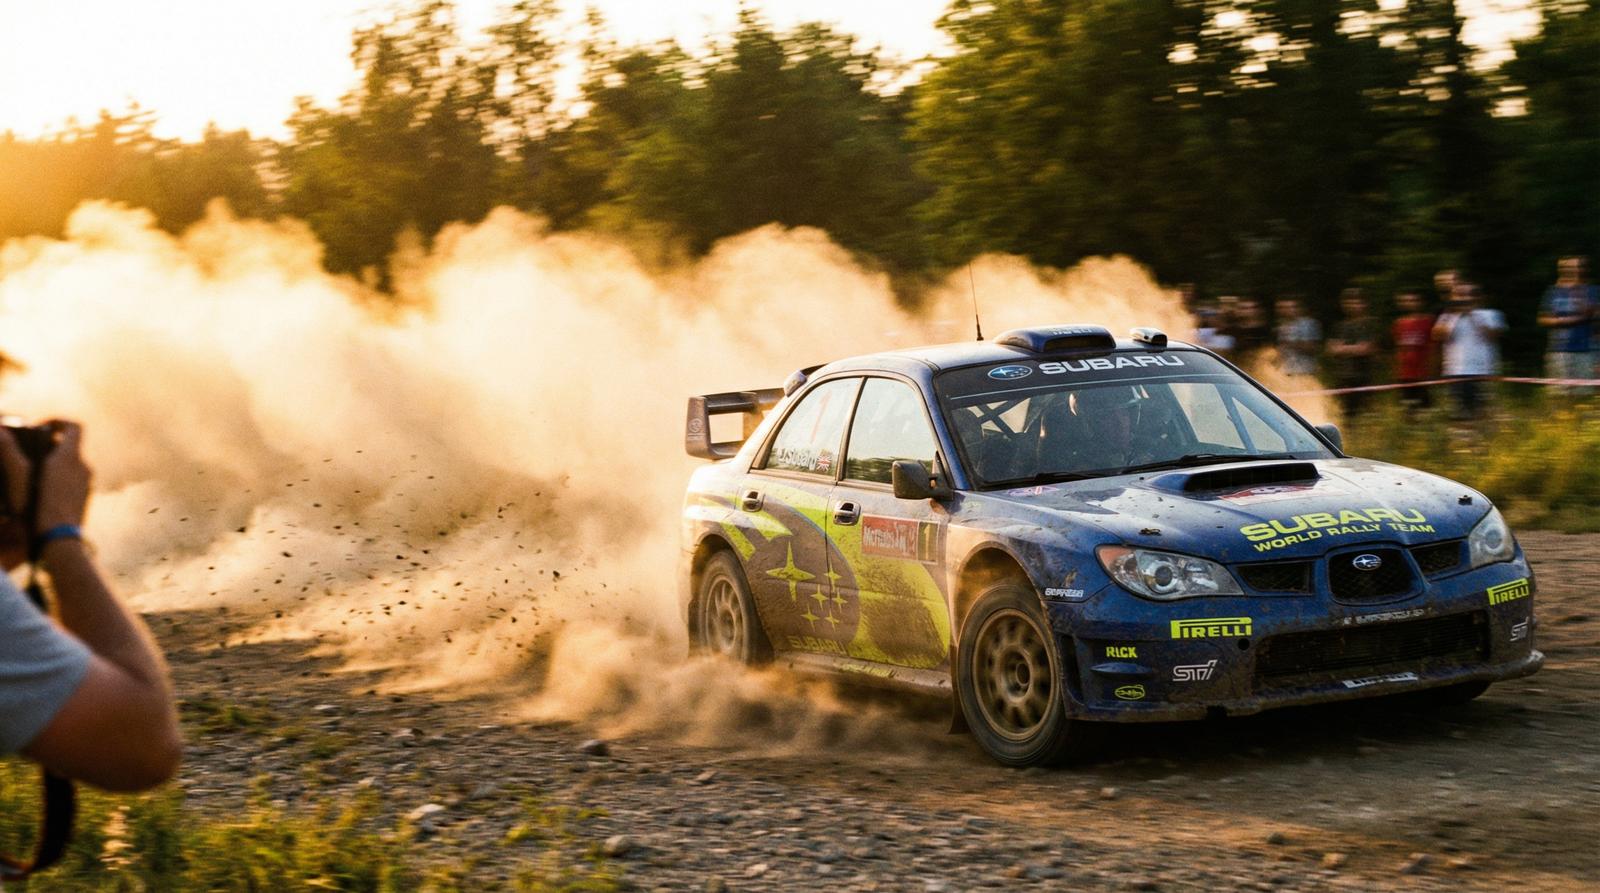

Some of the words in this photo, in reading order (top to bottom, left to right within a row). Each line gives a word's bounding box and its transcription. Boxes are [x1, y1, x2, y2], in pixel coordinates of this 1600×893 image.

[1038, 355, 1185, 375] SUBARU
[1240, 508, 1427, 542] SUBARU
[1254, 530, 1323, 552] WORLD
[1328, 523, 1381, 537] RALLY
[1386, 522, 1436, 534] TEAM
[1486, 577, 1530, 606] PIRELLI
[1170, 616, 1253, 639] PIRELLI
[1106, 646, 1138, 659] RICK
